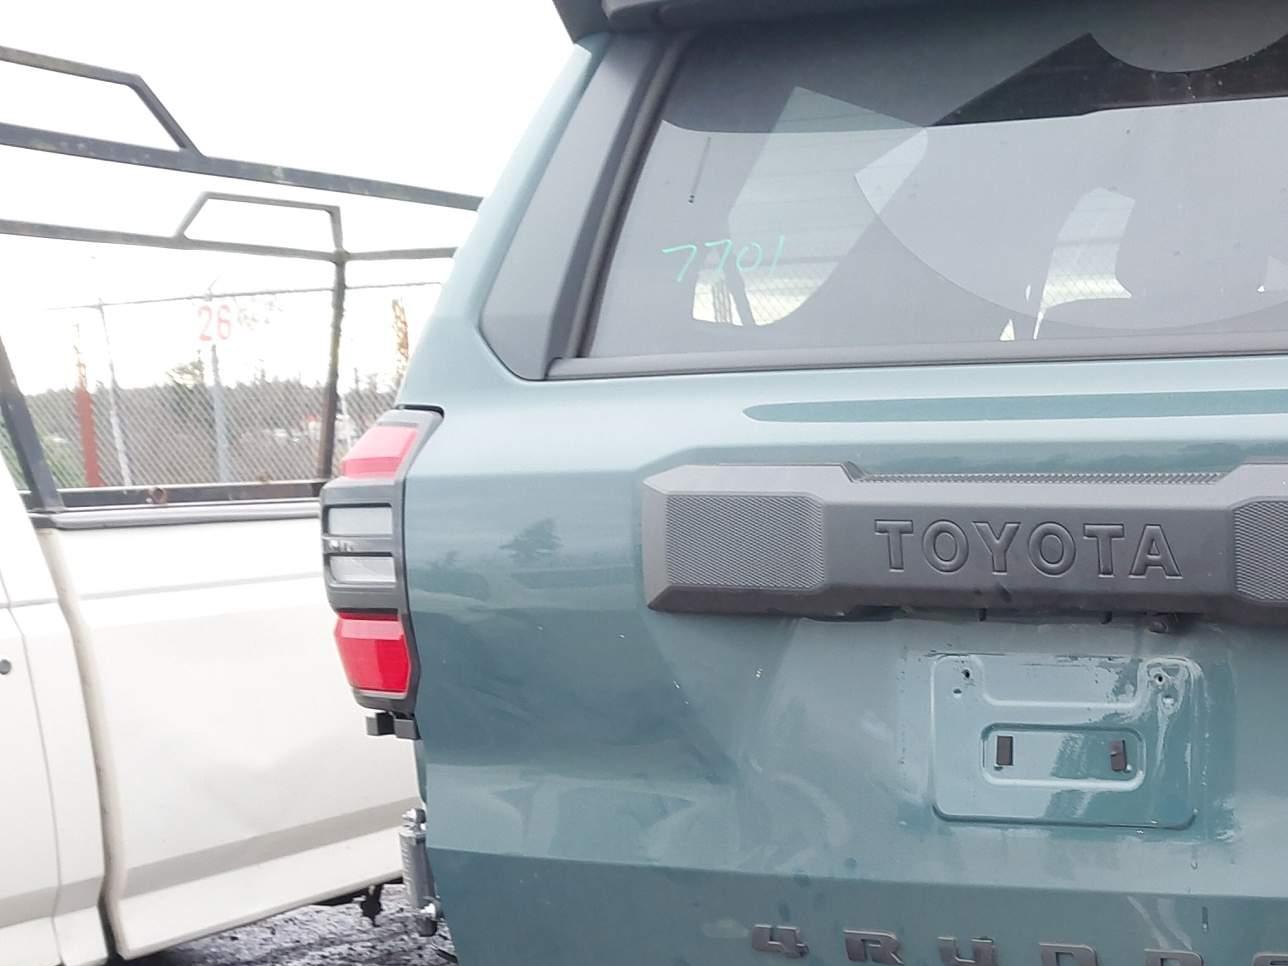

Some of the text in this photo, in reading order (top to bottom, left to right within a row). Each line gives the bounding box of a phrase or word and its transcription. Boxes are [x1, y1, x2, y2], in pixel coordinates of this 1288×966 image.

[661, 235, 785, 283] 7701
[197, 304, 232, 342] 26
[874, 518, 1184, 580] TOYOTA
